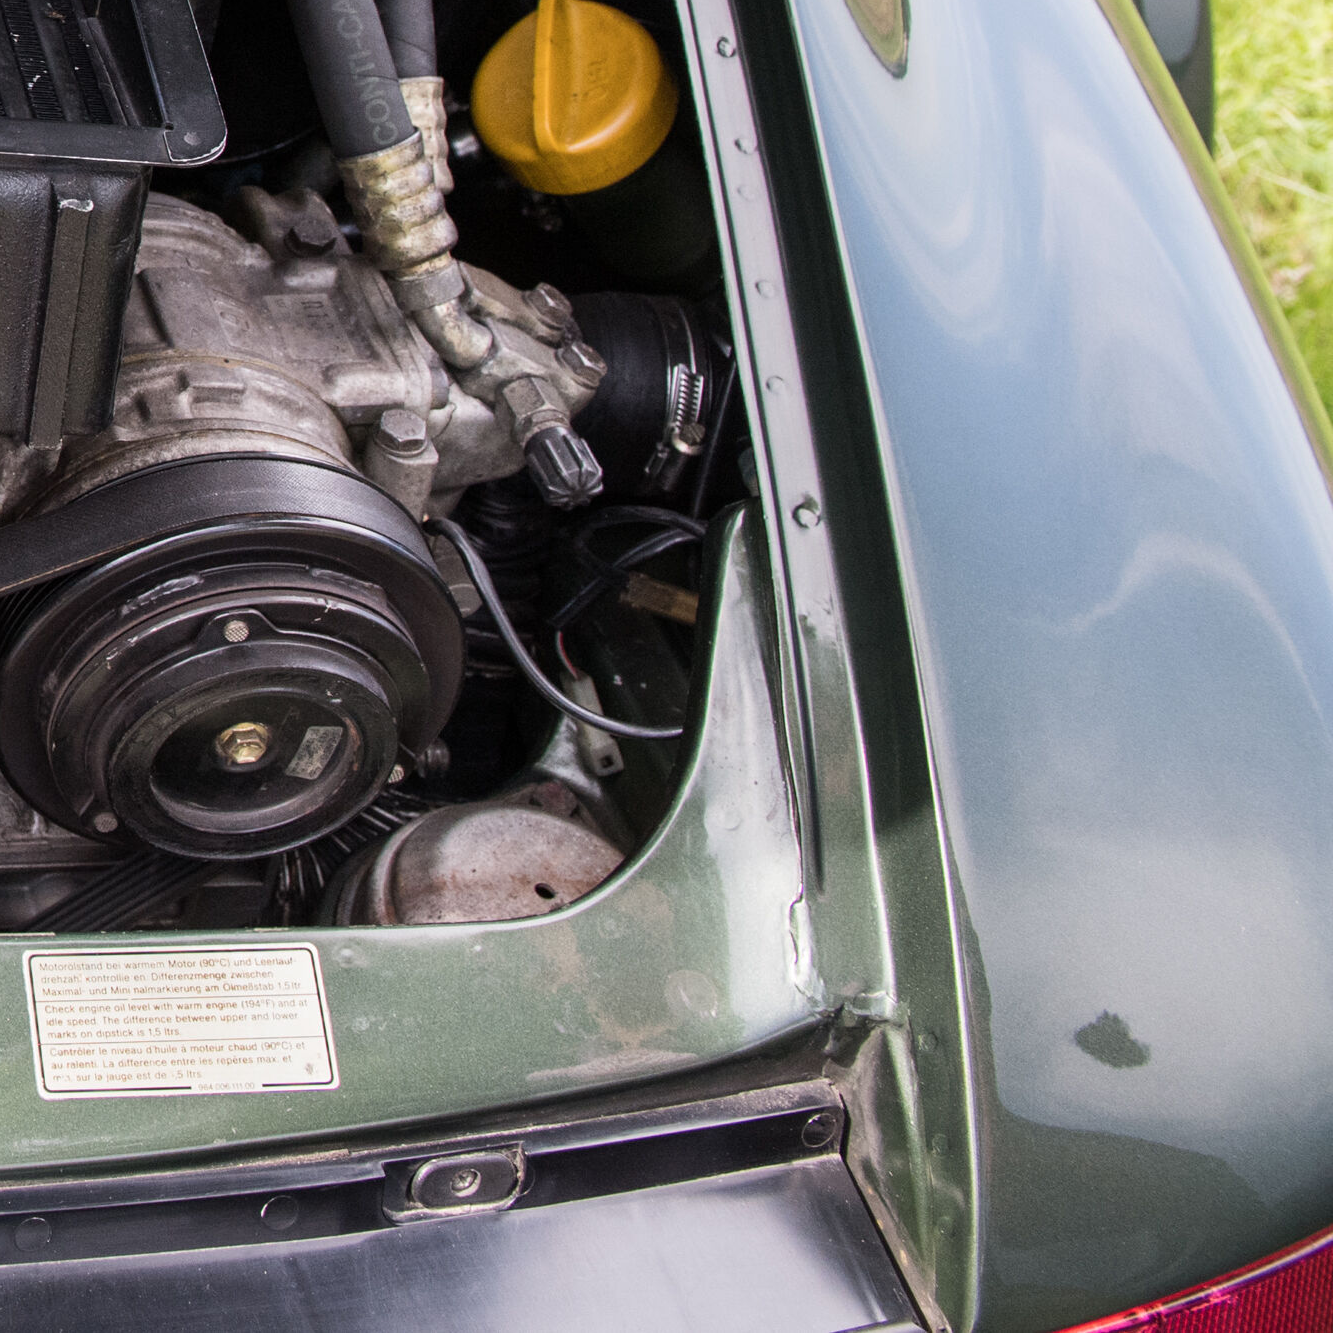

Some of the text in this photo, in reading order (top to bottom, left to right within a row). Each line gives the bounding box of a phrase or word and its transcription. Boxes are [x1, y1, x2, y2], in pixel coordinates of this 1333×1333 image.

[106, 961, 118, 970] bei
[124, 961, 165, 969] warmem
[168, 959, 196, 969] Motor
[233, 957, 252, 966] und
[151, 971, 227, 982] Differenzmenge
[230, 970, 274, 979] zwischen
[89, 986, 107, 996] und
[204, 984, 220, 992] am
[44, 1004, 75, 1014] Check
[78, 1004, 111, 1015] engine
[114, 1004, 126, 1012] oil
[128, 1003, 151, 1012] level
[153, 1002, 173, 1011] with
[176, 1002, 203, 1010] warm
[205, 1000, 238, 1011] engine
[278, 998, 296, 1007] and
[298, 999, 308, 1007] at
[46, 1018, 63, 1027] idle
[103, 1016, 120, 1025] The
[123, 1015, 172, 1025] difference
[175, 1014, 217, 1023] between
[220, 1012, 248, 1023] upper
[251, 1011, 269, 1020] and
[272, 1011, 298, 1020] lower
[47, 1030, 77, 1039] marks
[96, 1028, 133, 1040] dipstick
[148, 1027, 162, 1038] 1,5
[99, 1046, 108, 1055] le
[111, 1046, 143, 1055] niveau
[146, 1044, 178, 1054] d'huile
[180, 1043, 187, 1053] à
[190, 1043, 224, 1053] moteur
[228, 1041, 258, 1051] chaud
[296, 1041, 306, 1050] et
[51, 1061, 63, 1070] au
[102, 1059, 115, 1068] La
[170, 1057, 196, 1067] entre
[199, 1056, 213, 1066] les
[216, 1055, 254, 1066] repères
[282, 1054, 292, 1064] et
[76, 1073, 92, 1081] sur
[94, 1072, 103, 1081] la
[106, 1071, 133, 1083] jauge
[136, 1071, 151, 1080] est
[154, 1070, 167, 1080] de
